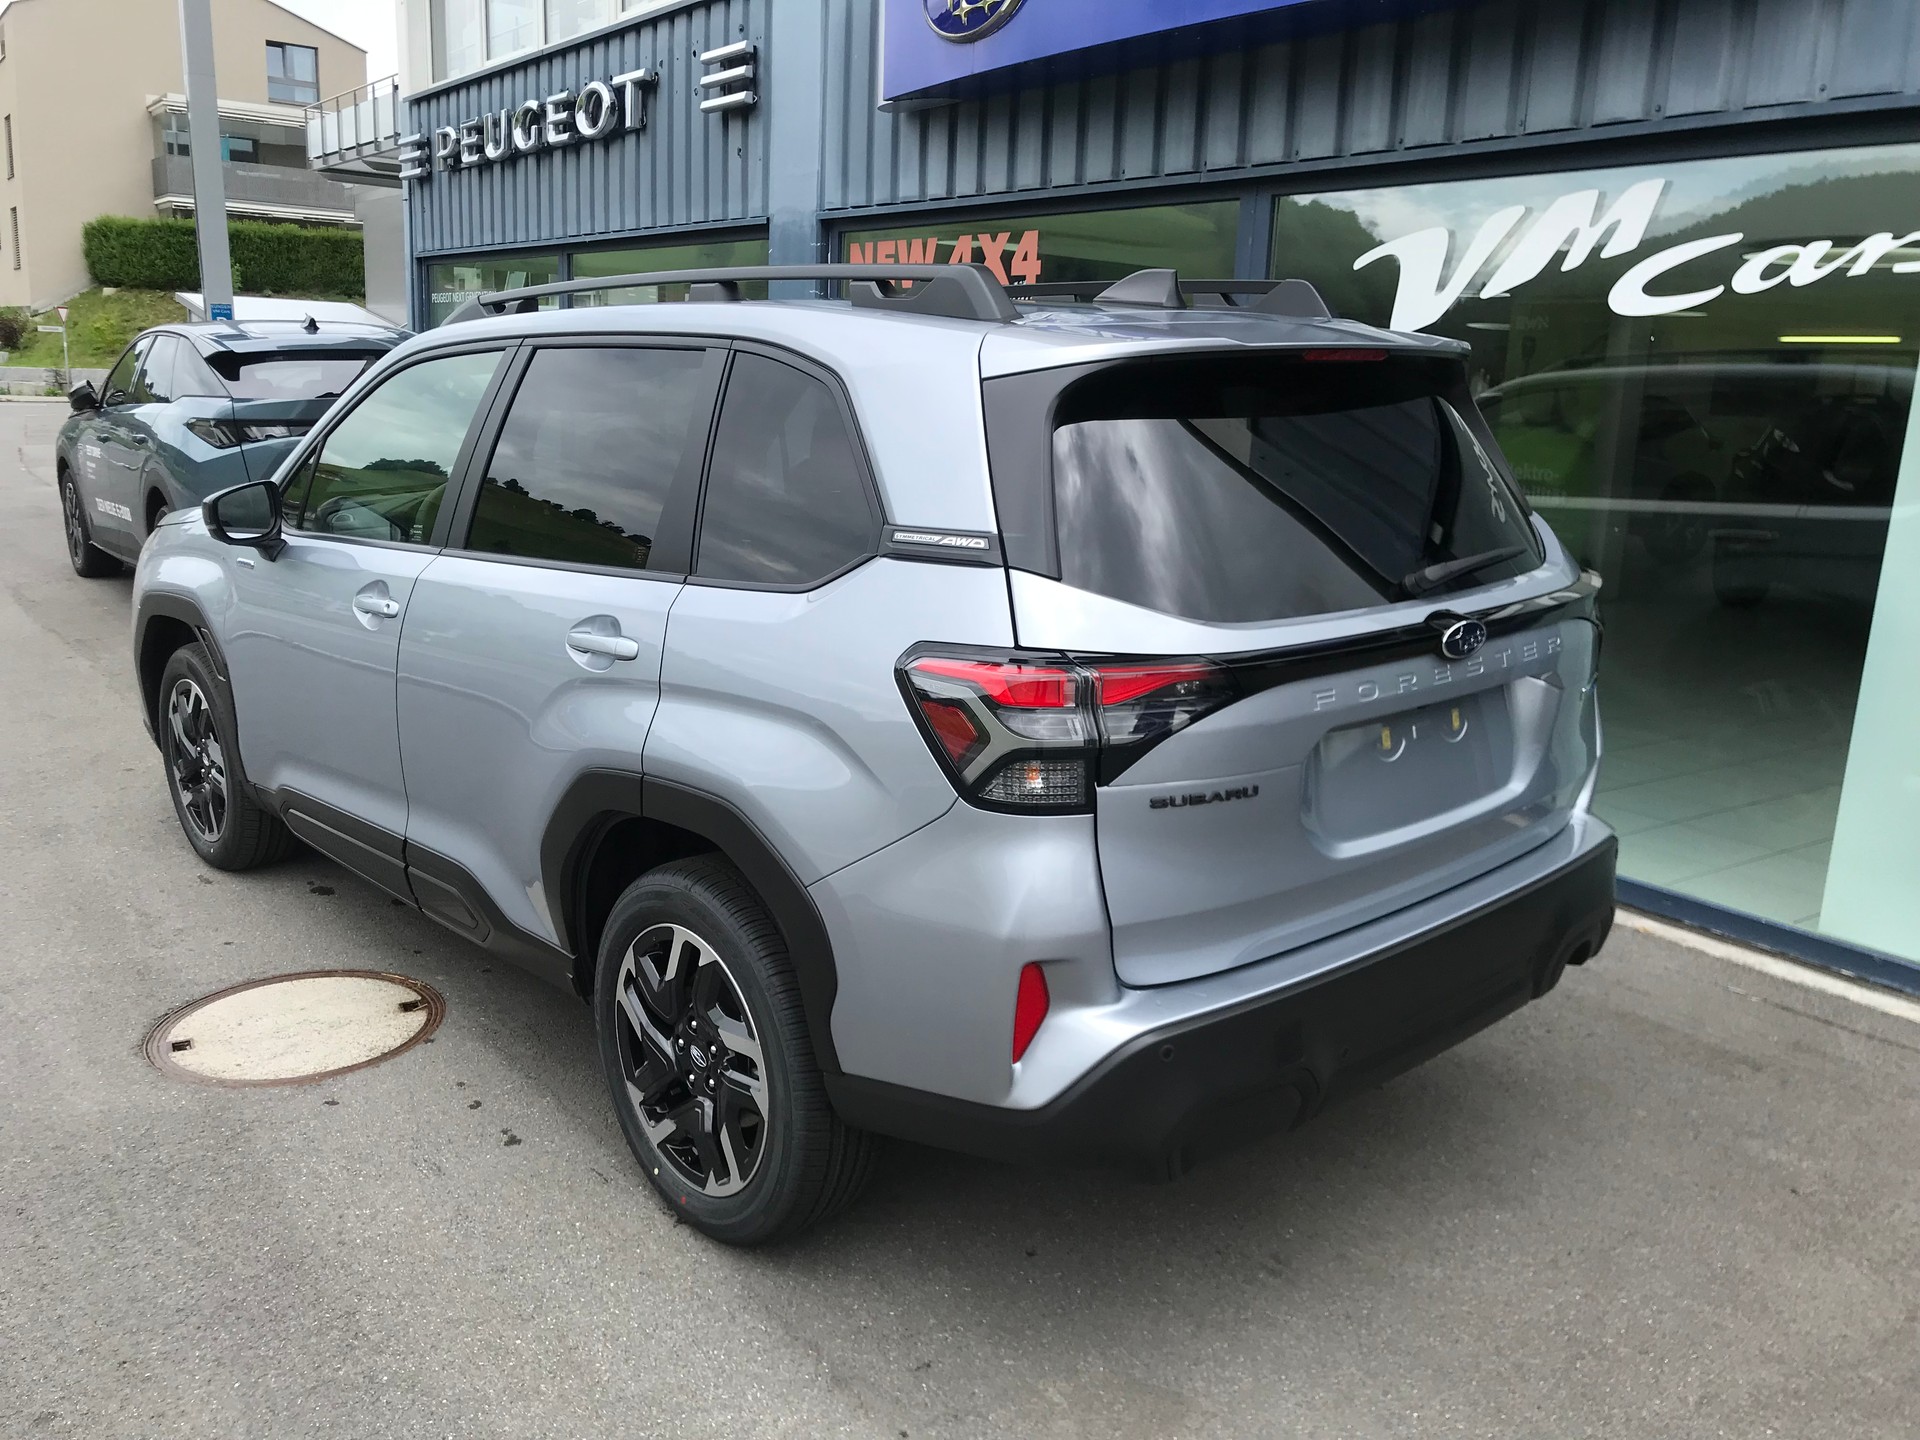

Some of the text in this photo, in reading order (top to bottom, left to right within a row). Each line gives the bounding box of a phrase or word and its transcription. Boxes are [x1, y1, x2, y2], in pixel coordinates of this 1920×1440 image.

[436, 68, 655, 172] PEUGEOT
[1353, 178, 1666, 332] VM
[432, 292, 452, 303] PEUGEOT
[453, 292, 465, 303] NEXT
[939, 536, 985, 548] AWD
[1312, 636, 1561, 712] FORESTER
[1149, 785, 1259, 809] SUBARU
